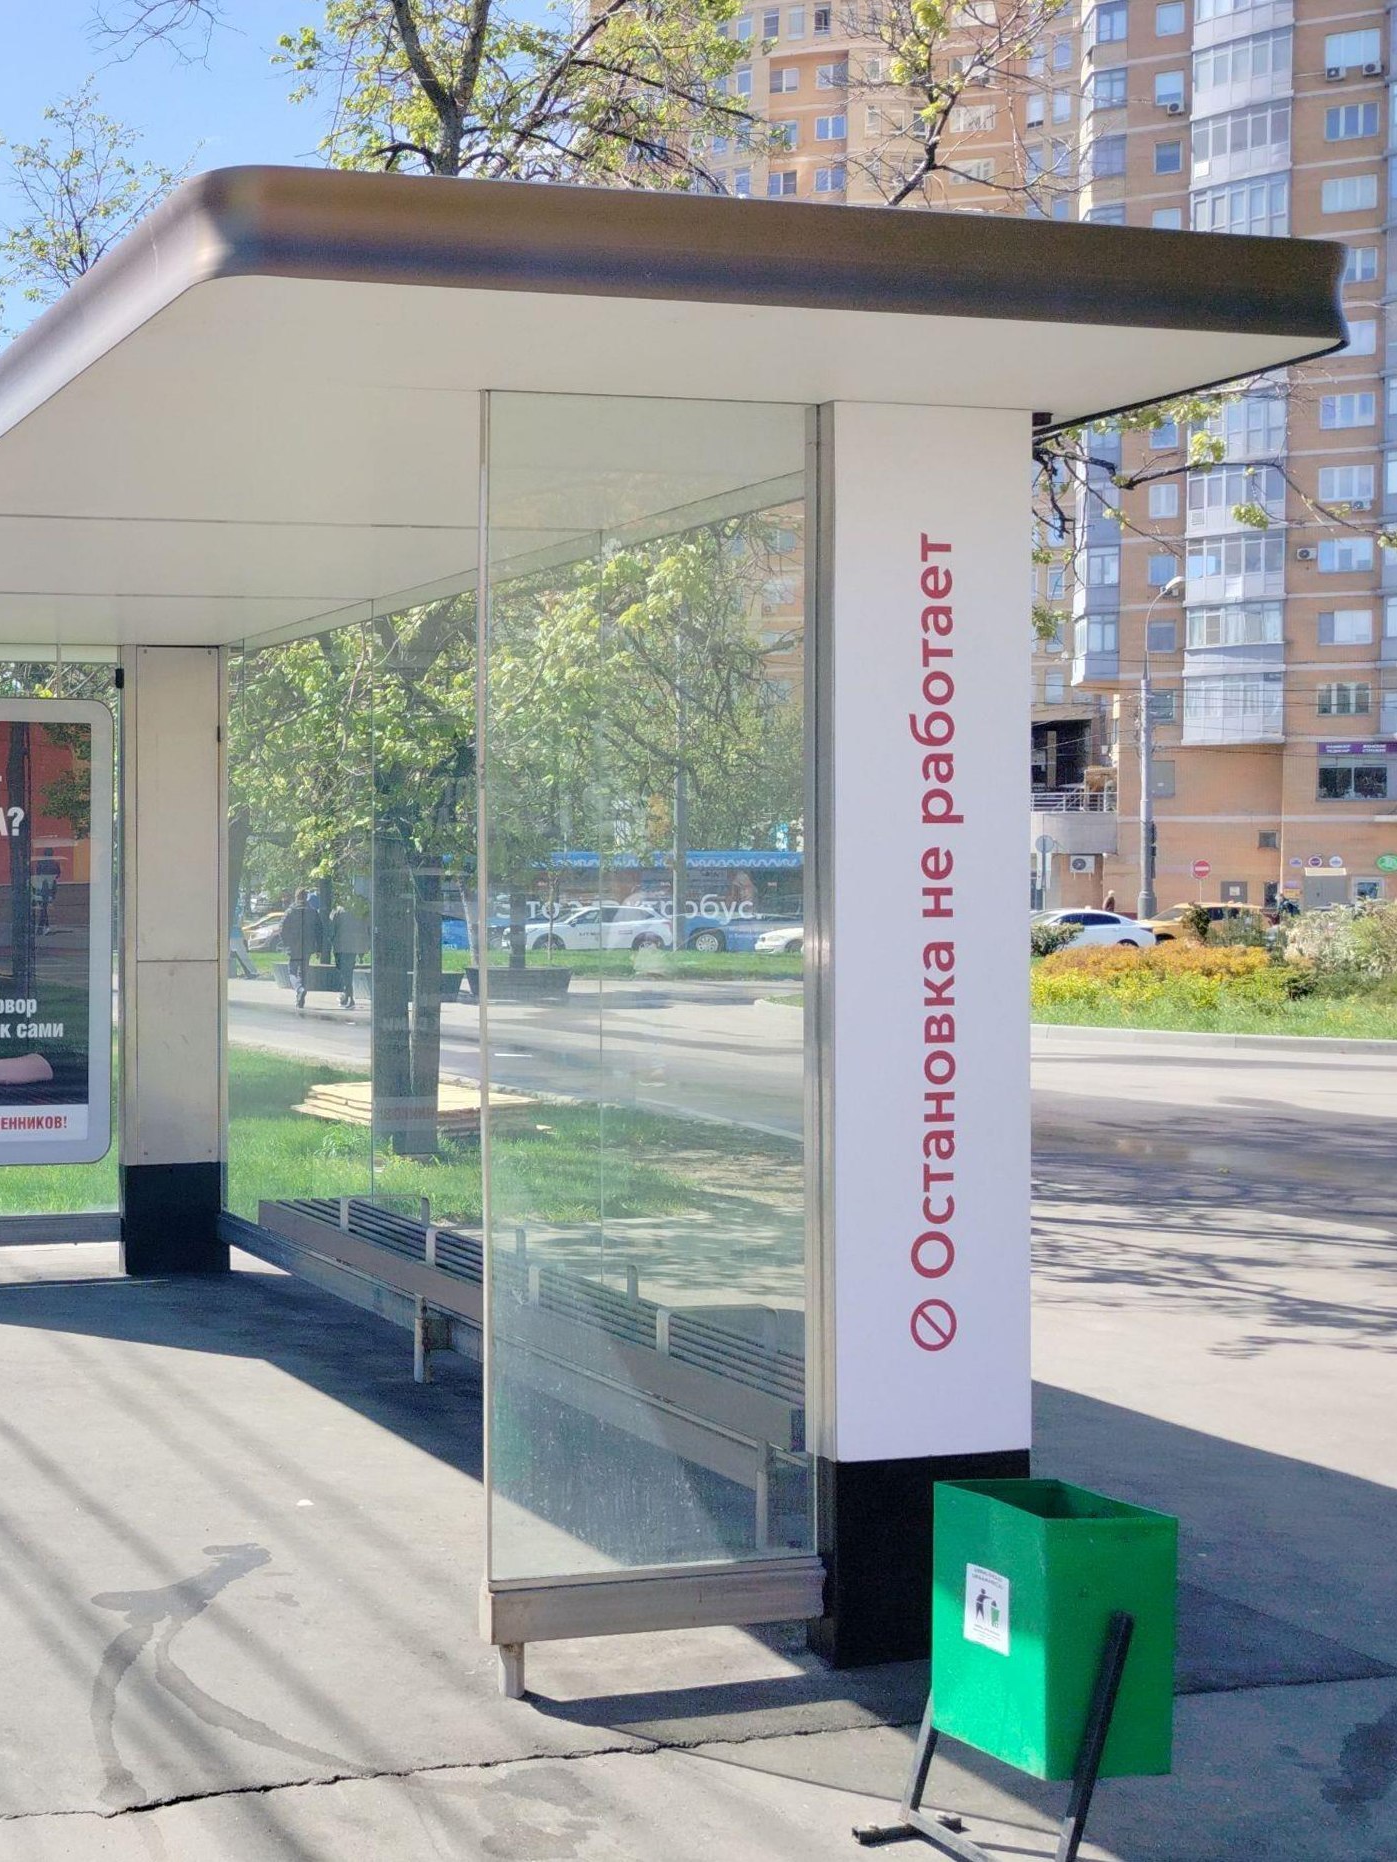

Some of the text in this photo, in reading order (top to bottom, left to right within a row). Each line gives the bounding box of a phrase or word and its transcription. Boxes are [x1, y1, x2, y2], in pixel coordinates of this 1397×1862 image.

[16, 1022, 64, 1038] сами
[908, 532, 965, 1280] Остановка не работает
